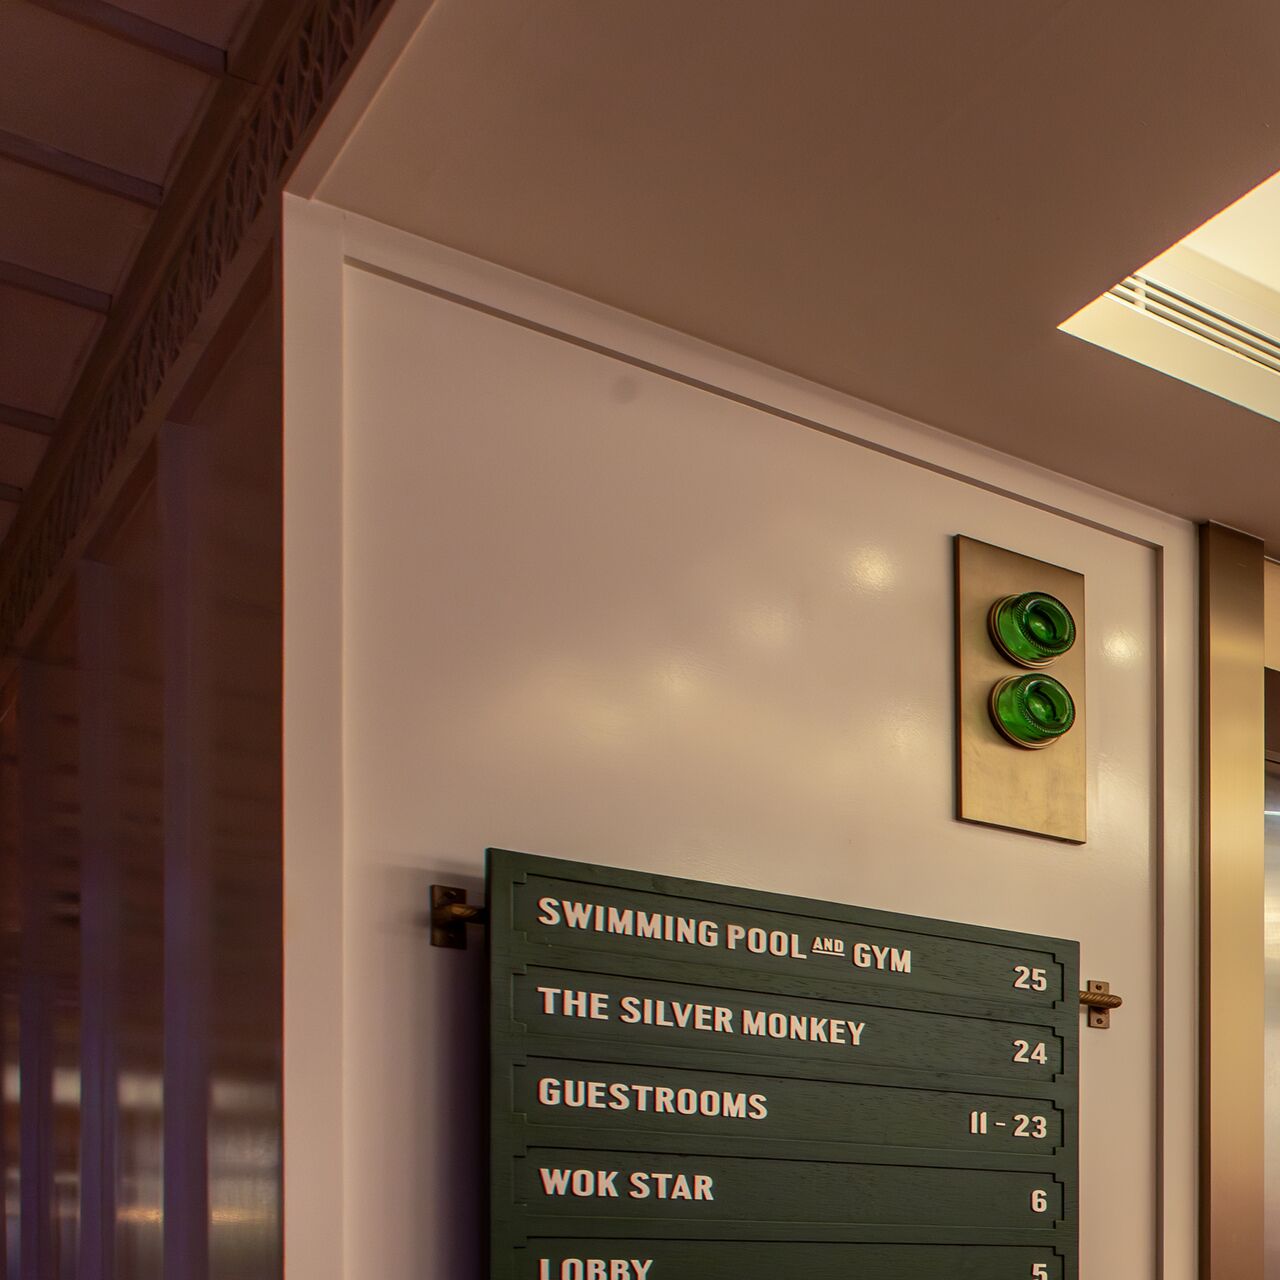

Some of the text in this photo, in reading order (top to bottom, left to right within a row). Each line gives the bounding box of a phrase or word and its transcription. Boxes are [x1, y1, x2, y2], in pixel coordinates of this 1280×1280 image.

[537, 897, 1049, 992] SWIMMING POOL AND GYM 25
[537, 986, 1049, 1065] THE SILVER MONKEY 24
[538, 1077, 769, 1120] GUESTROOMS
[1013, 1114, 1049, 1139] 23
[540, 1168, 1048, 1213] WOK STAR 6
